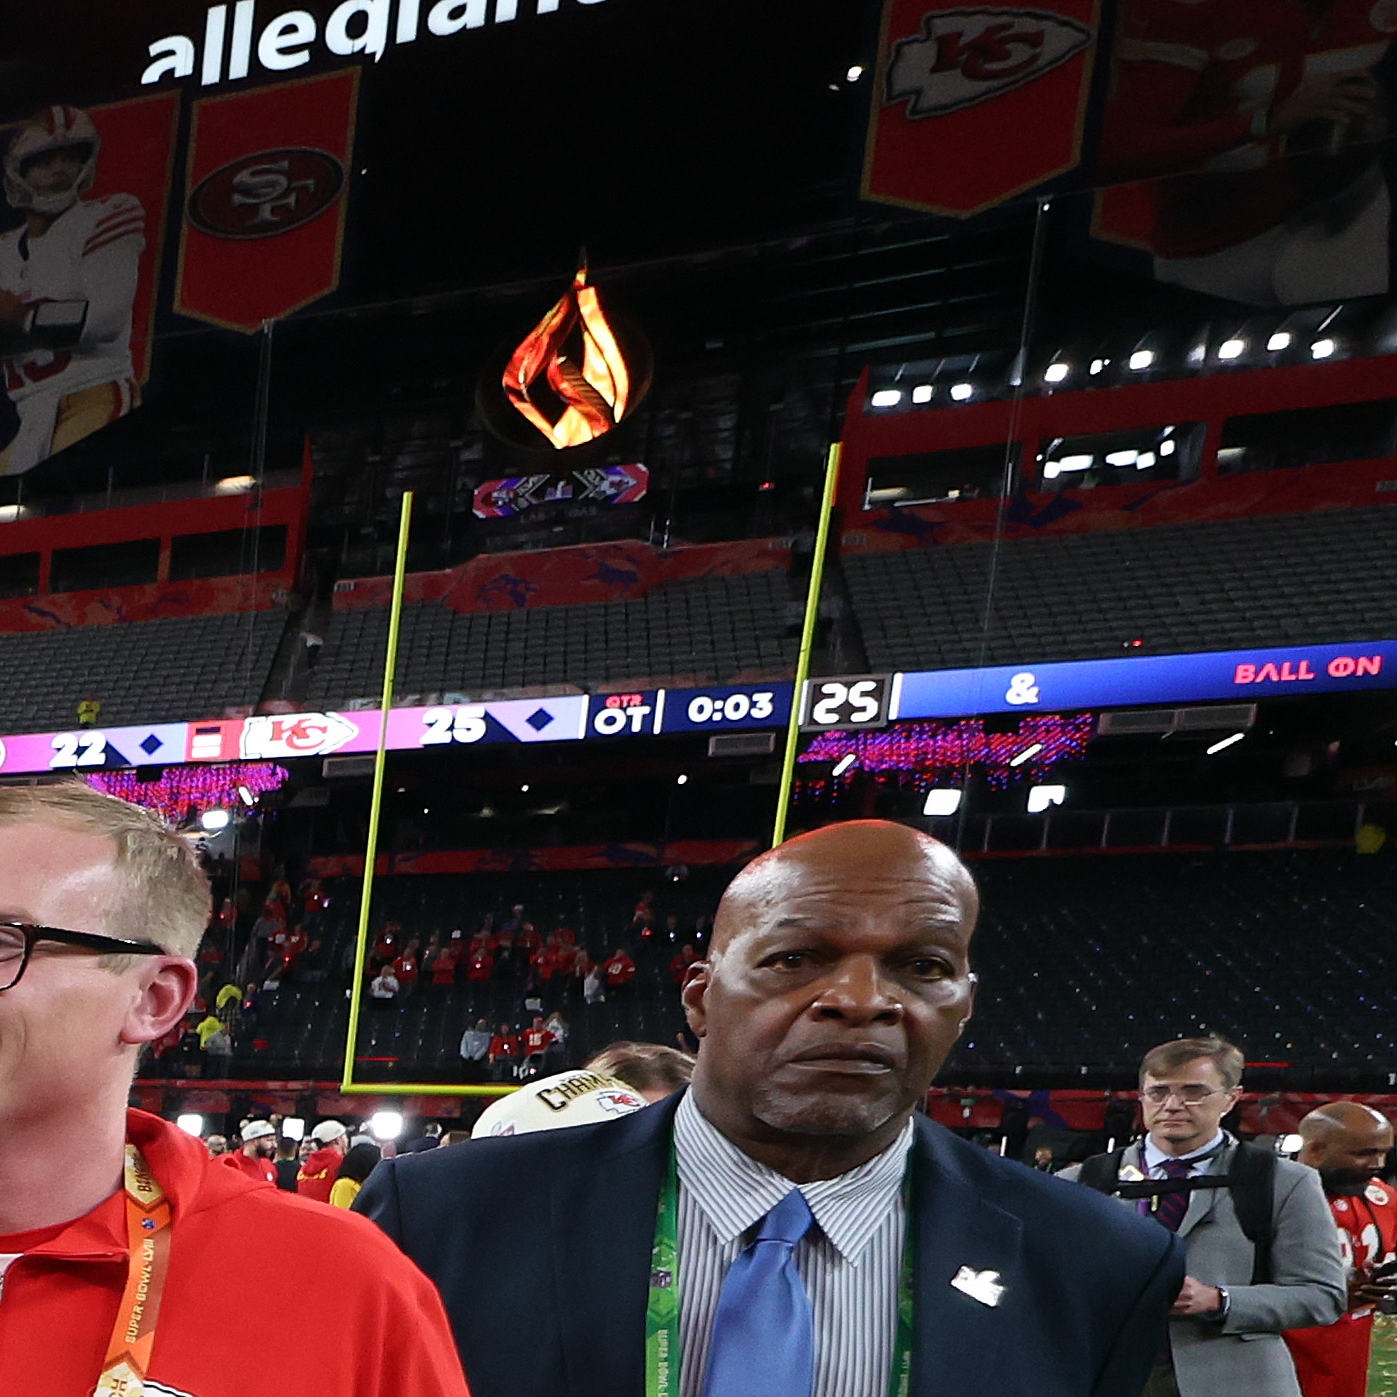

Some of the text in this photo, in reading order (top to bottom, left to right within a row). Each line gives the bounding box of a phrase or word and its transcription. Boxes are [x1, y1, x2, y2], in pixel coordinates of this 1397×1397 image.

[1235, 654, 1382, 684] BALL ON
[606, 693, 642, 709] QTR
[813, 681, 880, 724] 25
[1006, 673, 1040, 706] &
[594, 705, 650, 735] OT
[688, 692, 774, 723] 0:03
[420, 707, 486, 745] 25
[49, 732, 106, 767] 22
[125, 1309, 144, 1344] SUPER
[136, 1266, 152, 1307] BOWL
